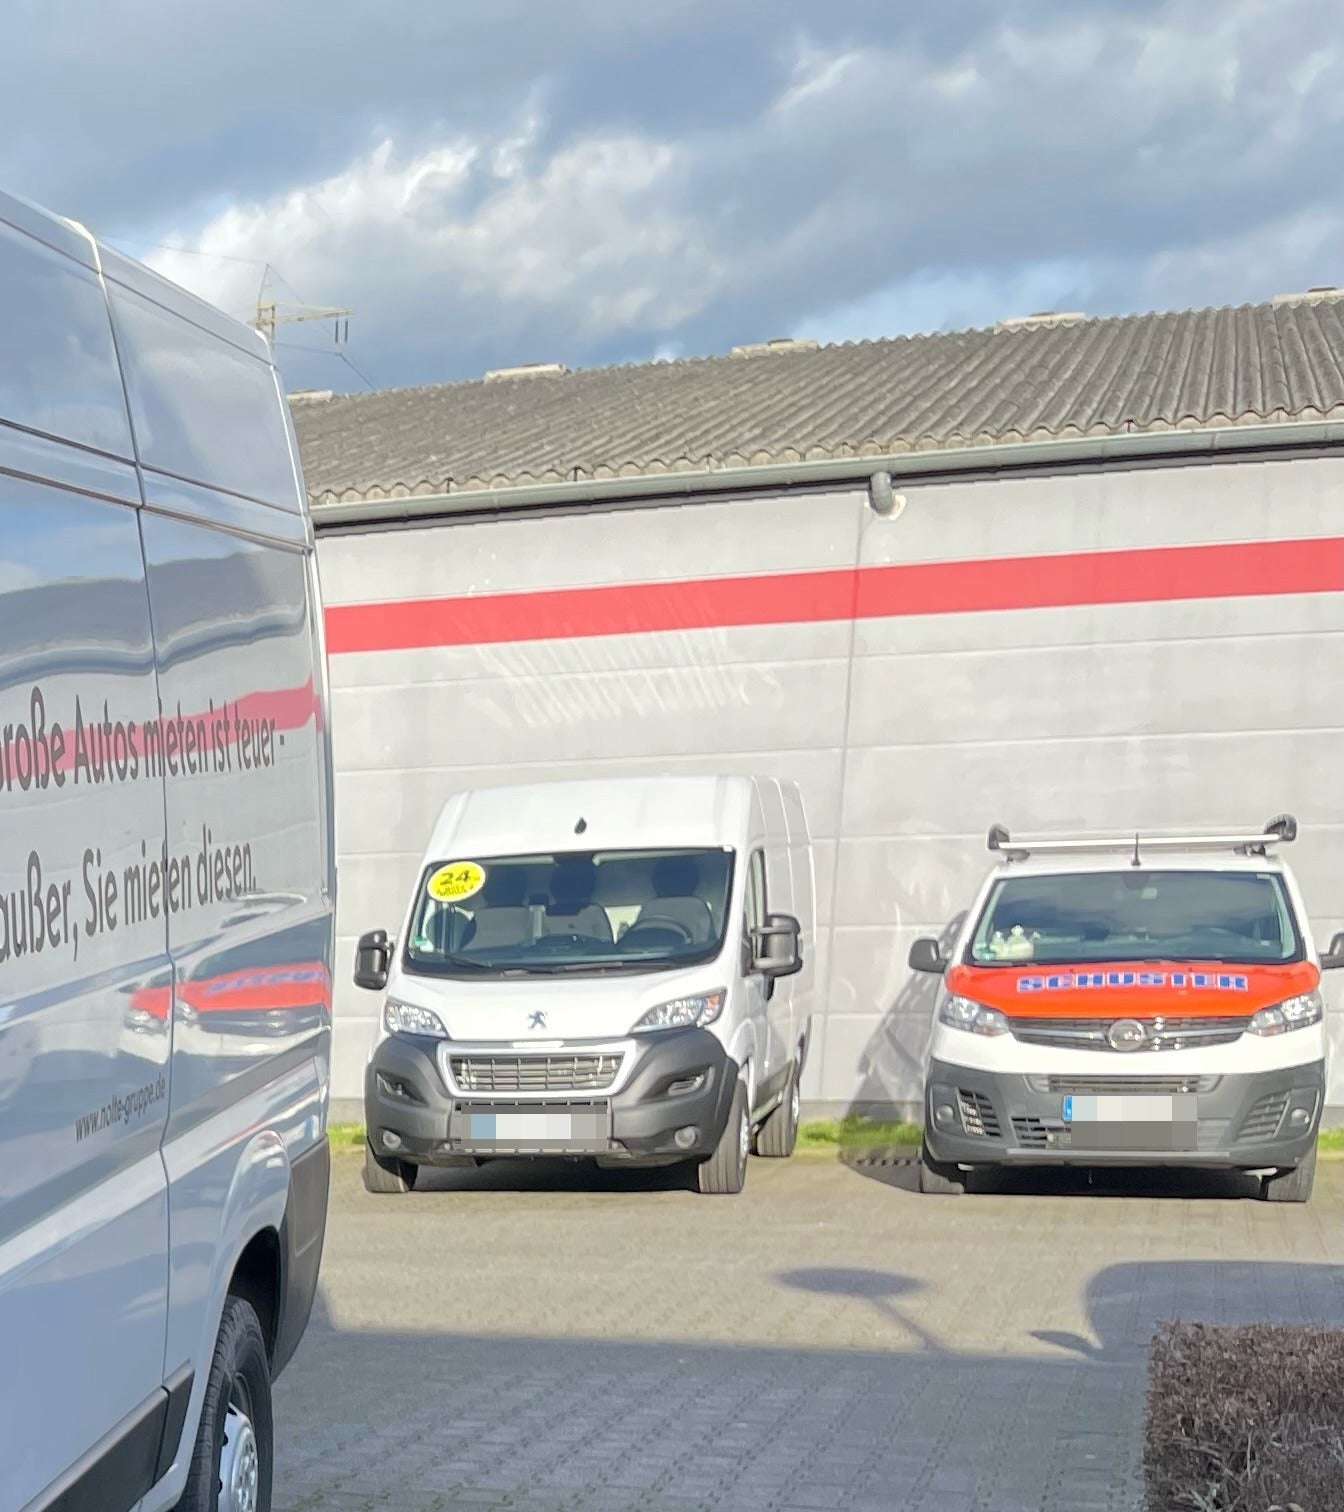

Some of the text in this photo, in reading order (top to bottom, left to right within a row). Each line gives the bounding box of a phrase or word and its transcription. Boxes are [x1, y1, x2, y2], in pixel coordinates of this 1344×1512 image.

[74, 694, 139, 784] Autos
[143, 698, 207, 778] mieten
[209, 698, 232, 772] ist
[234, 708, 276, 768] teuer
[82, 846, 117, 938] Sie
[123, 838, 192, 927] mieten
[196, 823, 257, 907] diesen.
